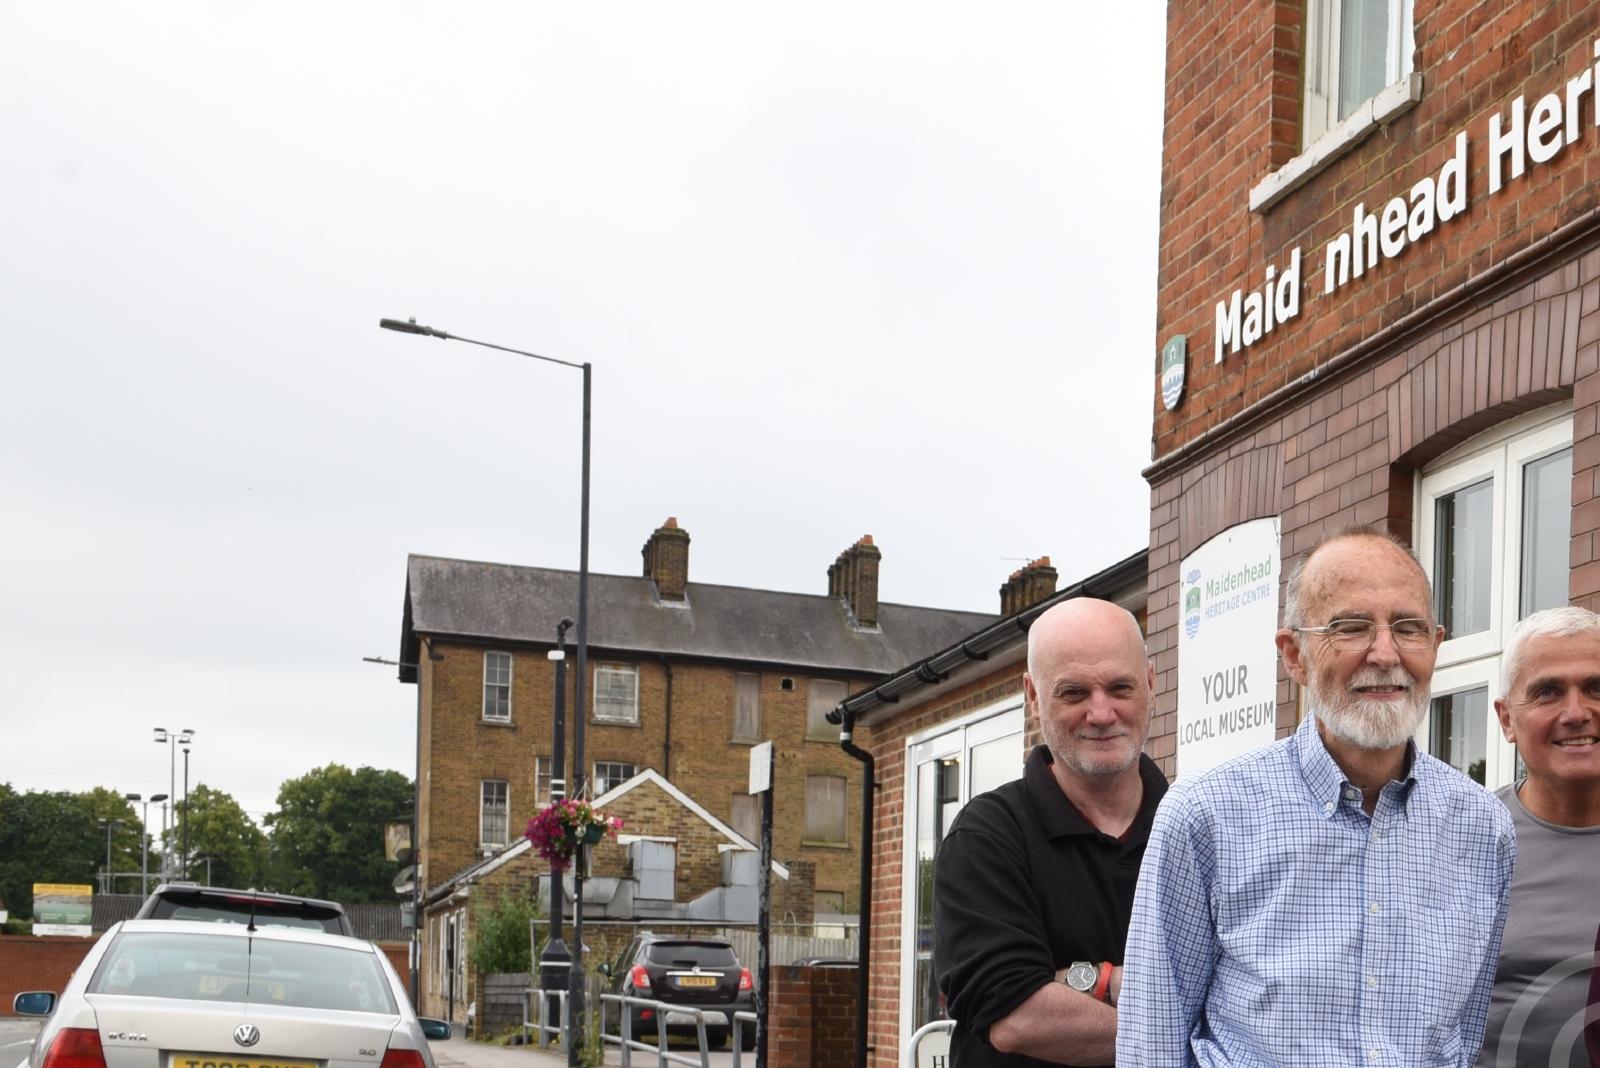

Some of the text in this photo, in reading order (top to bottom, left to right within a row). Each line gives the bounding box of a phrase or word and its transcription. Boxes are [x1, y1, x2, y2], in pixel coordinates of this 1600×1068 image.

[1214, 246, 1301, 365] Maid
[1324, 130, 1468, 295] nhead
[1206, 553, 1271, 601] Maidenhead
[1205, 582, 1271, 619] HERITAGE CENTRE
[1202, 664, 1248, 704] YOUR
[1180, 700, 1274, 745] LOCAL MUSEUM
